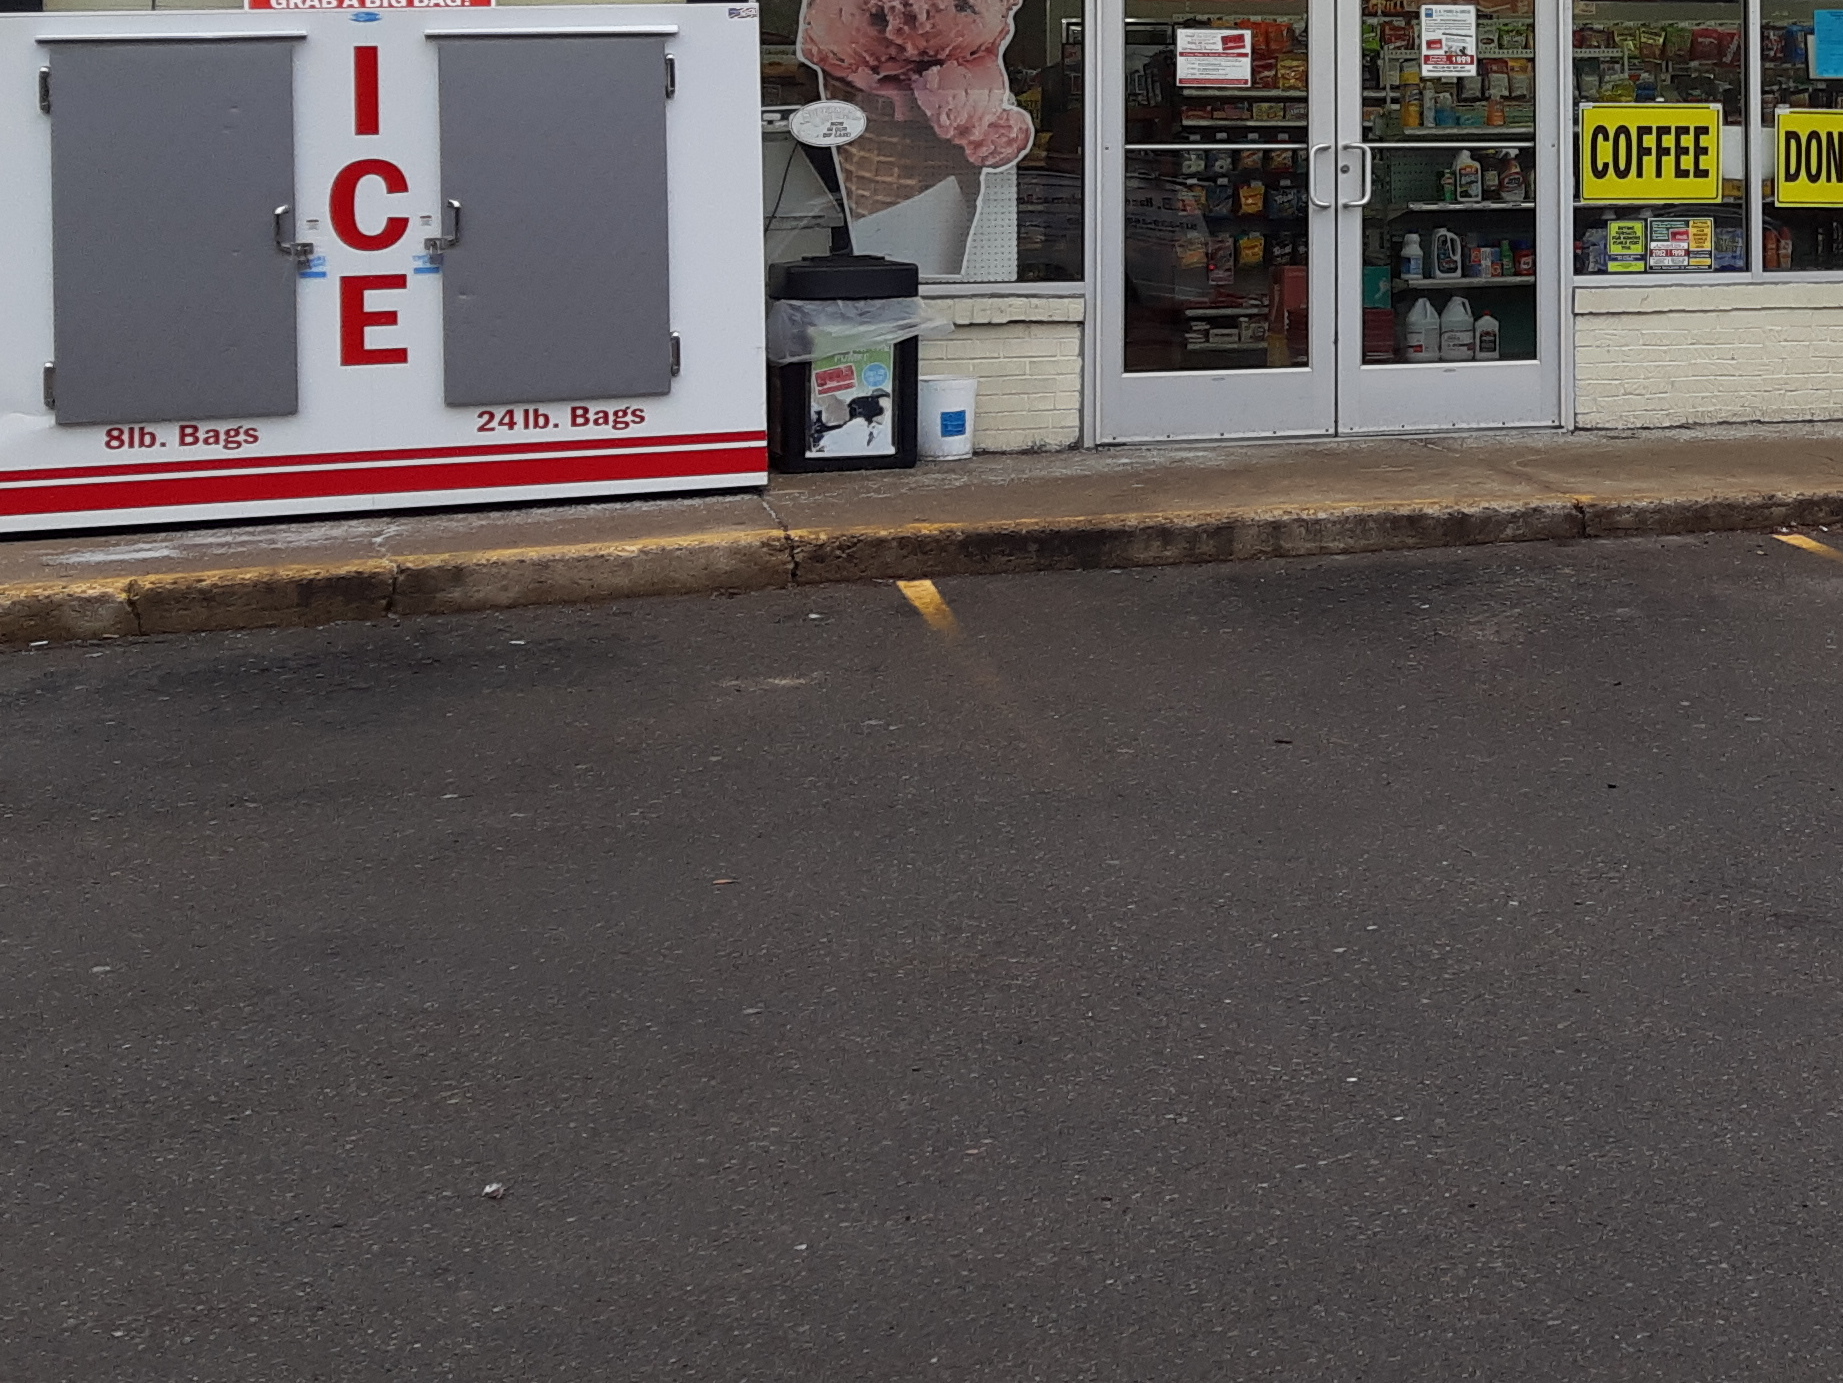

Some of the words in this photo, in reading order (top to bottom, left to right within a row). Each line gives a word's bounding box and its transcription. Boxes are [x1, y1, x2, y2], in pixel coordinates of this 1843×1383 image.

[1590, 123, 1710, 181] COFFEE
[328, 45, 411, 367] ICE
[103, 424, 169, 451] 8lb.
[178, 423, 260, 452] Bags
[569, 403, 647, 432] Bags
